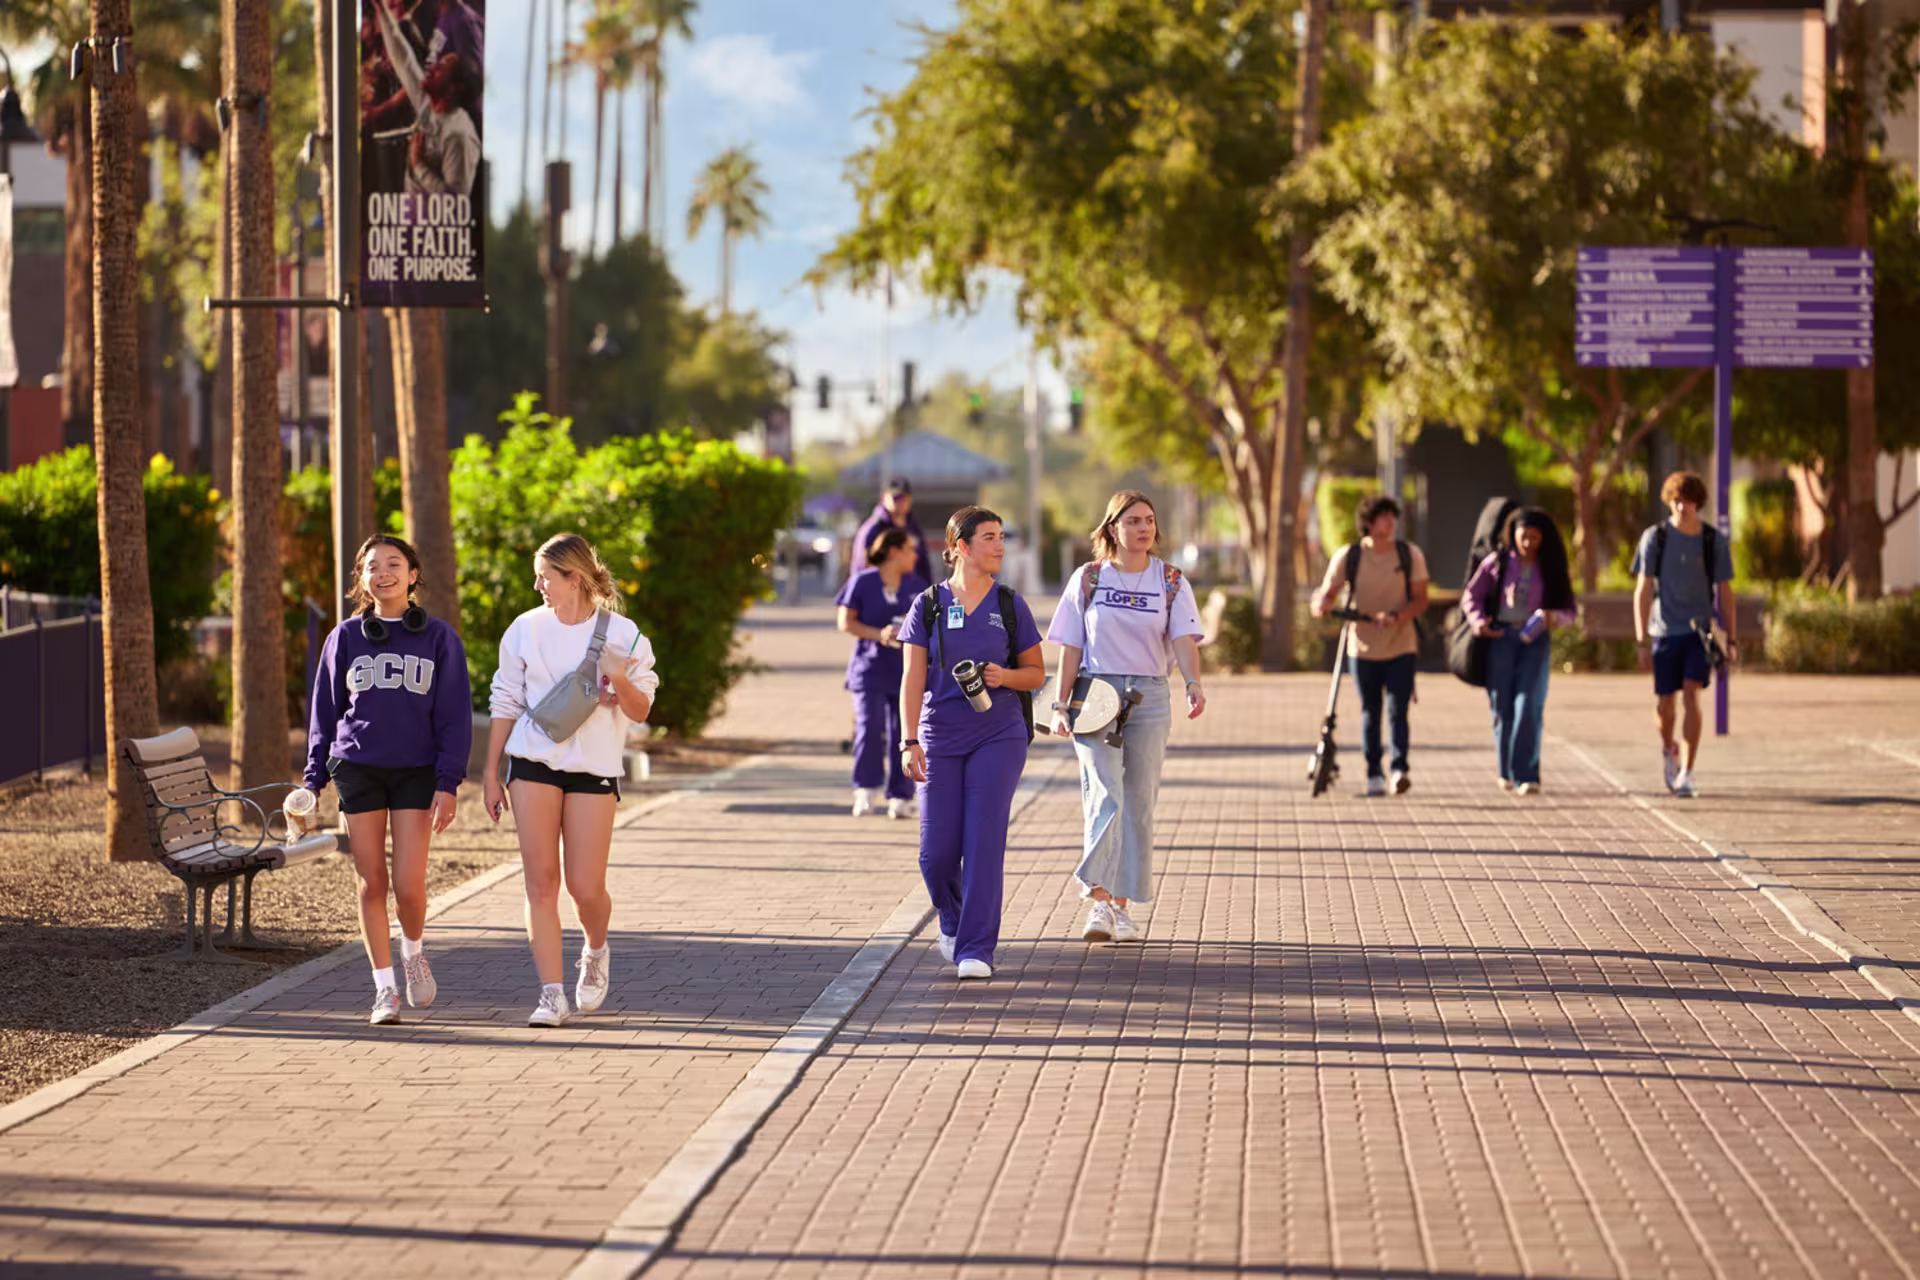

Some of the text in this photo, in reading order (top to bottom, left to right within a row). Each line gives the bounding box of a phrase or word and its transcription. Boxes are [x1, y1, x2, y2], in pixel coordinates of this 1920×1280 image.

[368, 192, 476, 227] ONE LORD.
[368, 226, 476, 257] ONE FAITH.
[368, 256, 476, 282] ONE PURPOSE.
[1105, 591, 1148, 608] LOPES
[346, 653, 435, 695] GCU
[966, 675, 983, 692] GCU
